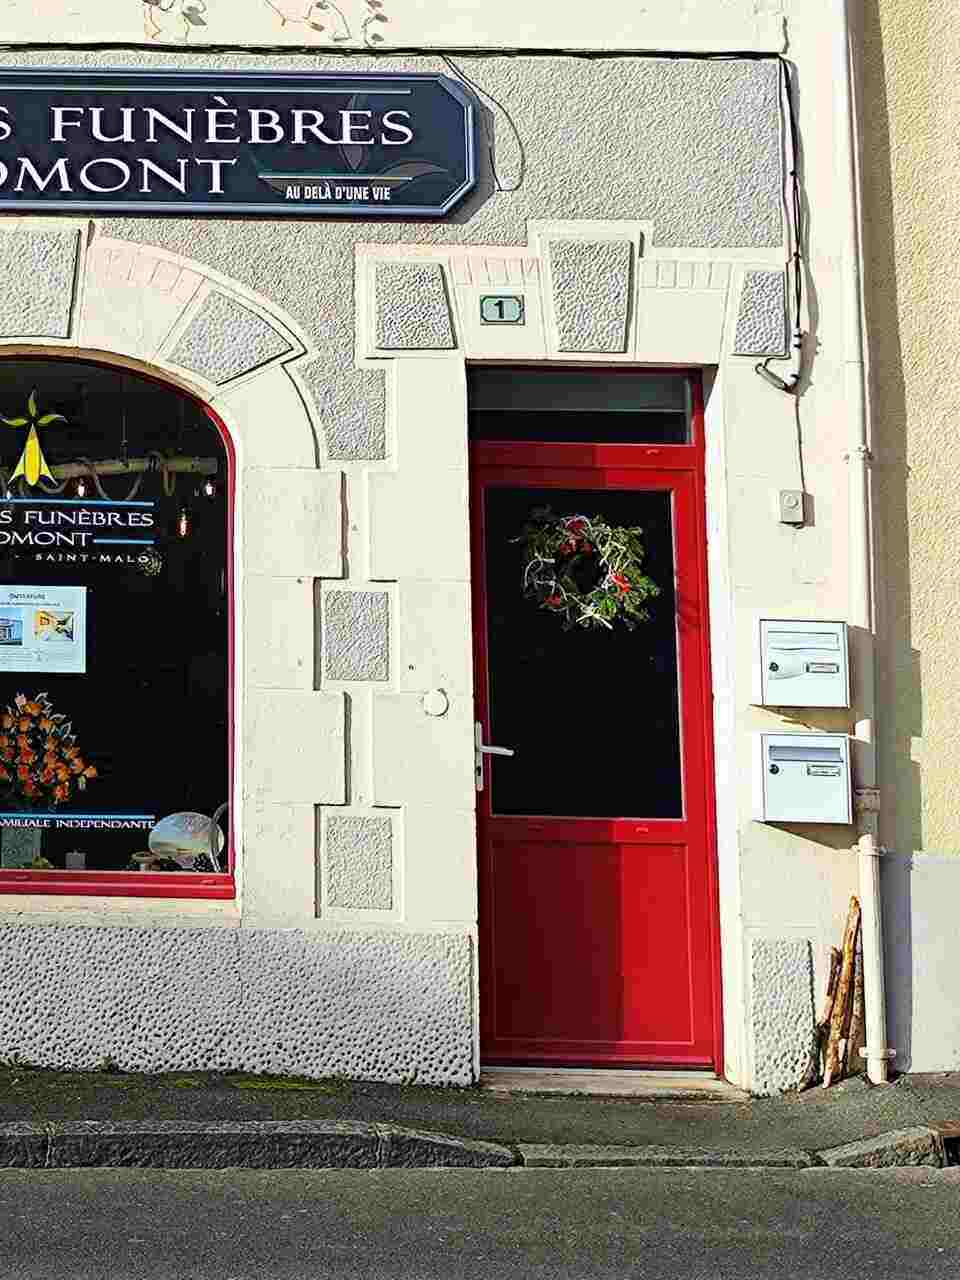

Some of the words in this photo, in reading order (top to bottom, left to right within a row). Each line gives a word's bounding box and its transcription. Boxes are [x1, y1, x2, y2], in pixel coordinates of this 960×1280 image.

[50, 95, 414, 145] FUNÈBRES
[285, 185, 300, 199] AU
[335, 185, 369, 200] D'UNE
[372, 186, 391, 200] VIE
[494, 299, 505, 320] 1
[24, 507, 155, 527] FUNÈBRES
[35, 553, 150, 564] SAINT-MALO
